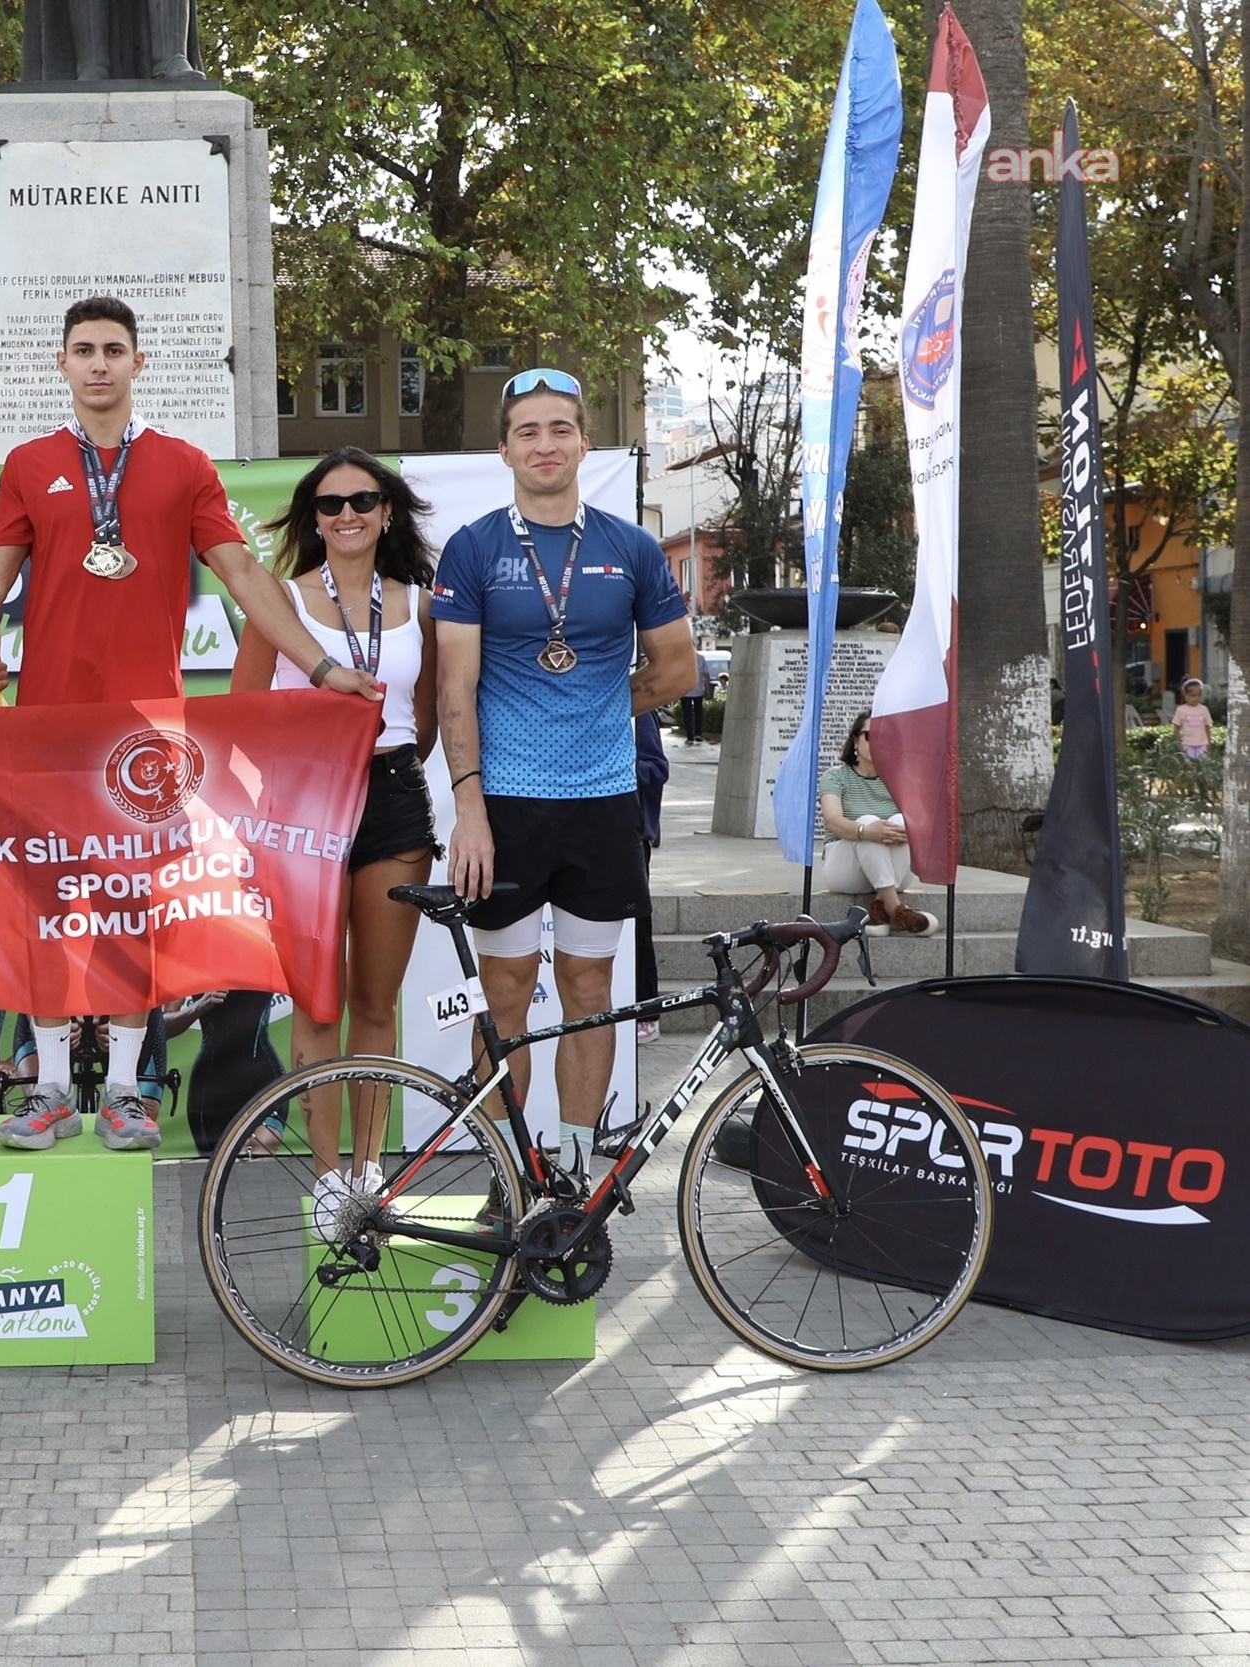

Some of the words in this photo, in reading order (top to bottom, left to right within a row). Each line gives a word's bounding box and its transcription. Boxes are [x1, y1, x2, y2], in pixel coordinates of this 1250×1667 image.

[9, 184, 129, 206] MÜTAREKE
[140, 184, 201, 204] ANITI
[11, 274, 48, 286] CEPHESİ
[50, 274, 91, 285] ORDULARI
[94, 273, 146, 284] KUMANDANI
[154, 272, 185, 284] EDİRNE
[188, 272, 226, 283] MEBUSU
[22, 288, 51, 300] FERİK
[54, 288, 84, 299] İSMET
[116, 287, 188, 298] HAZRETLERİNE
[47, 484, 74, 494] adidas
[227, 499, 275, 564] EYLÜL
[495, 556, 529, 583] BK
[25, 829, 162, 864] SİLAHLI
[56, 873, 152, 902] SPOR
[157, 847, 257, 889] GÜCÜ
[38, 886, 275, 940] KOMUTANLIĞI
[436, 992, 470, 1021] 443
[661, 988, 705, 1009] CUBE
[645, 1038, 730, 1155] CUBE
[840, 1151, 911, 1176] TEŞKİLAT
[843, 1099, 1024, 1177] SPOR
[1028, 1128, 1226, 1204] TOTO
[425, 1262, 482, 1333] 3
